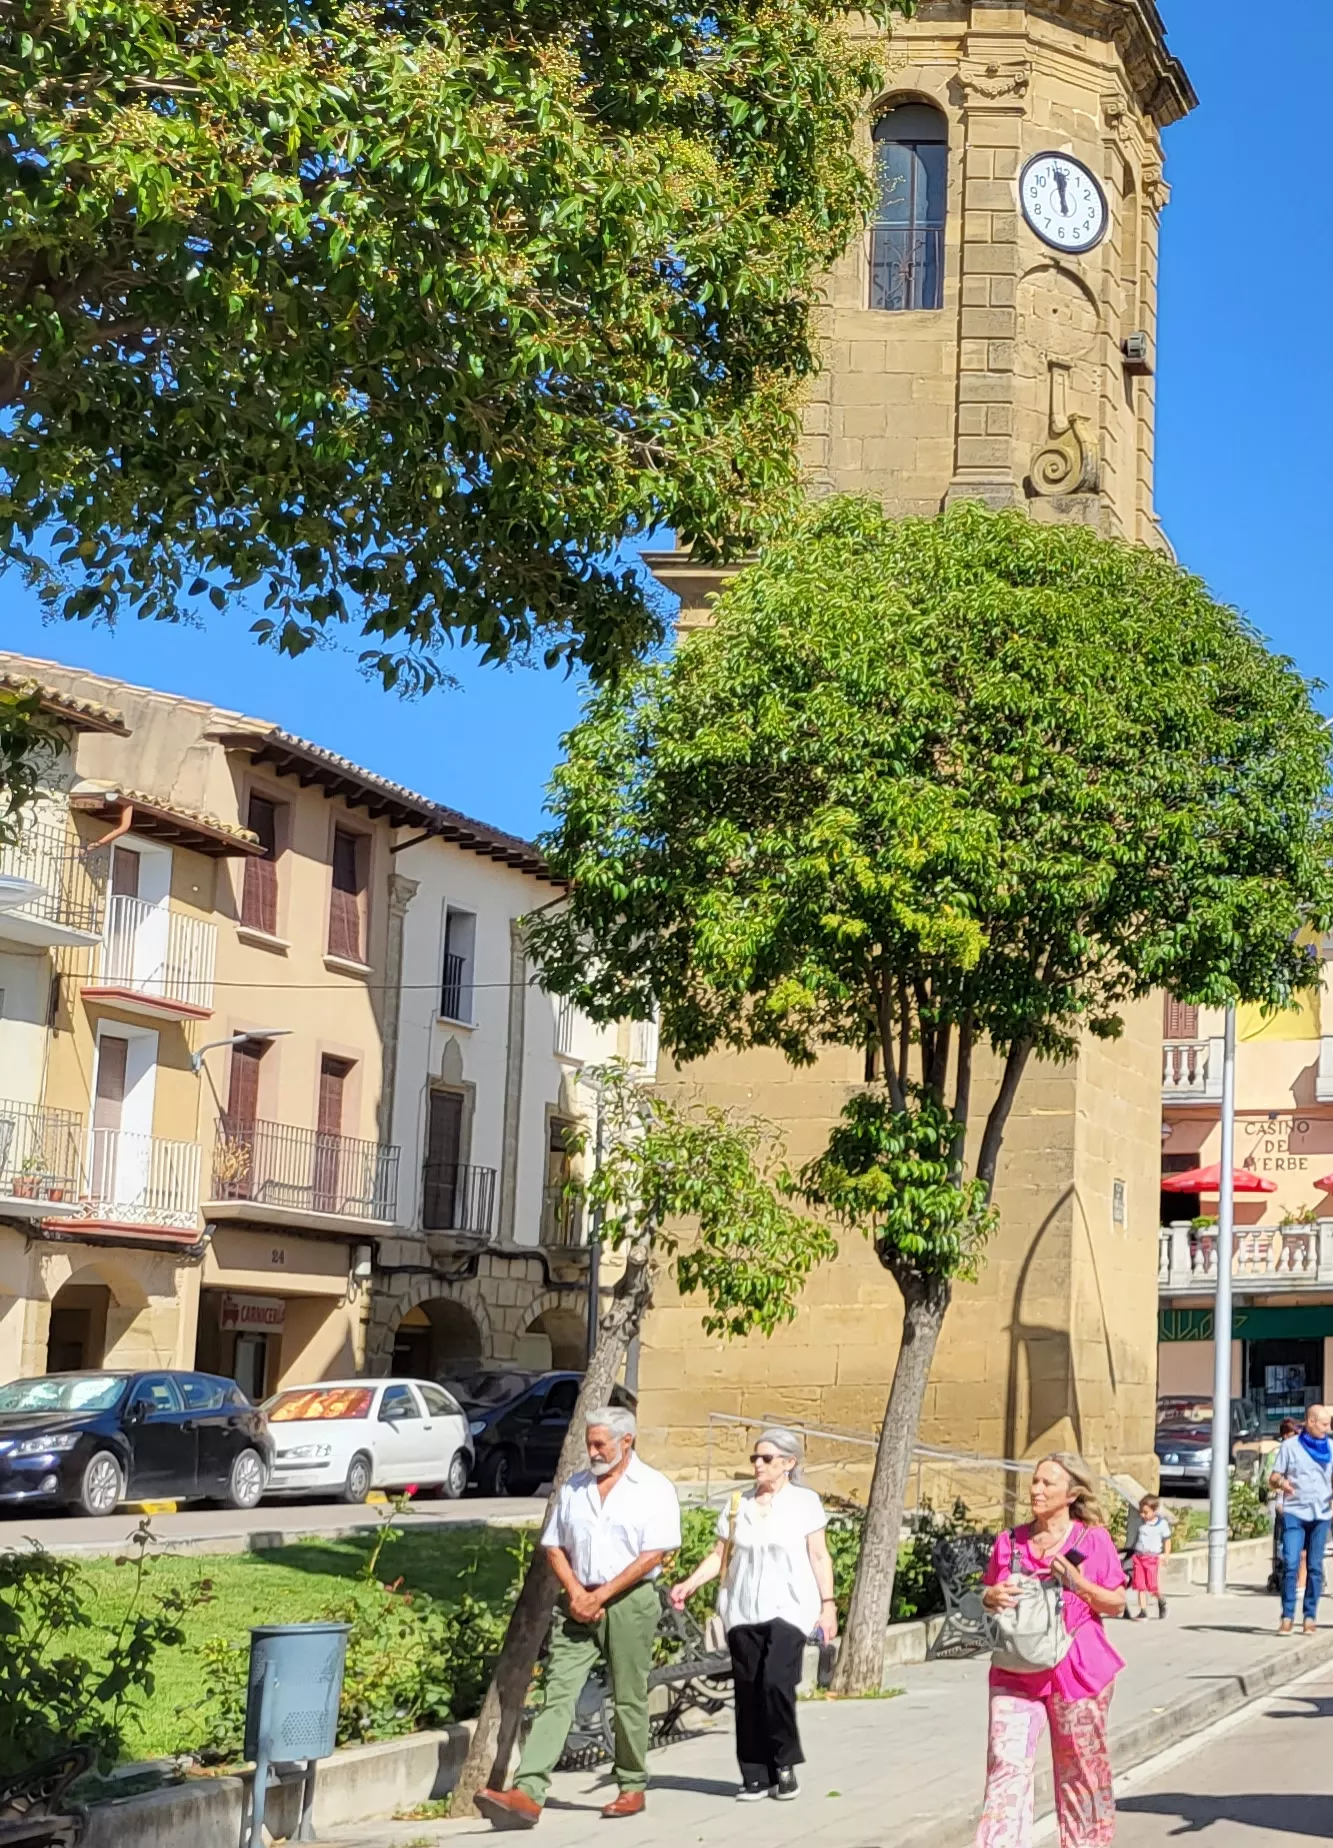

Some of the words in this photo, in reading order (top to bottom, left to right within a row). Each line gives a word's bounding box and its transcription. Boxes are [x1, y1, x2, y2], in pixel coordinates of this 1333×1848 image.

[1035, 175, 1046, 188] 10
[1075, 176, 1080, 188] 1
[1030, 186, 1038, 198] 9
[1084, 189, 1091, 201] 2
[1034, 204, 1042, 215] 8
[1088, 207, 1095, 218] 3
[1044, 217, 1052, 228] 7
[1083, 220, 1090, 231] 4
[1058, 227, 1065, 238] 6
[1073, 228, 1080, 239] 5
[1245, 1121, 1309, 1135] CASINO
[1265, 1140, 1289, 1153] DE
[272, 1250, 284, 1264] 24
